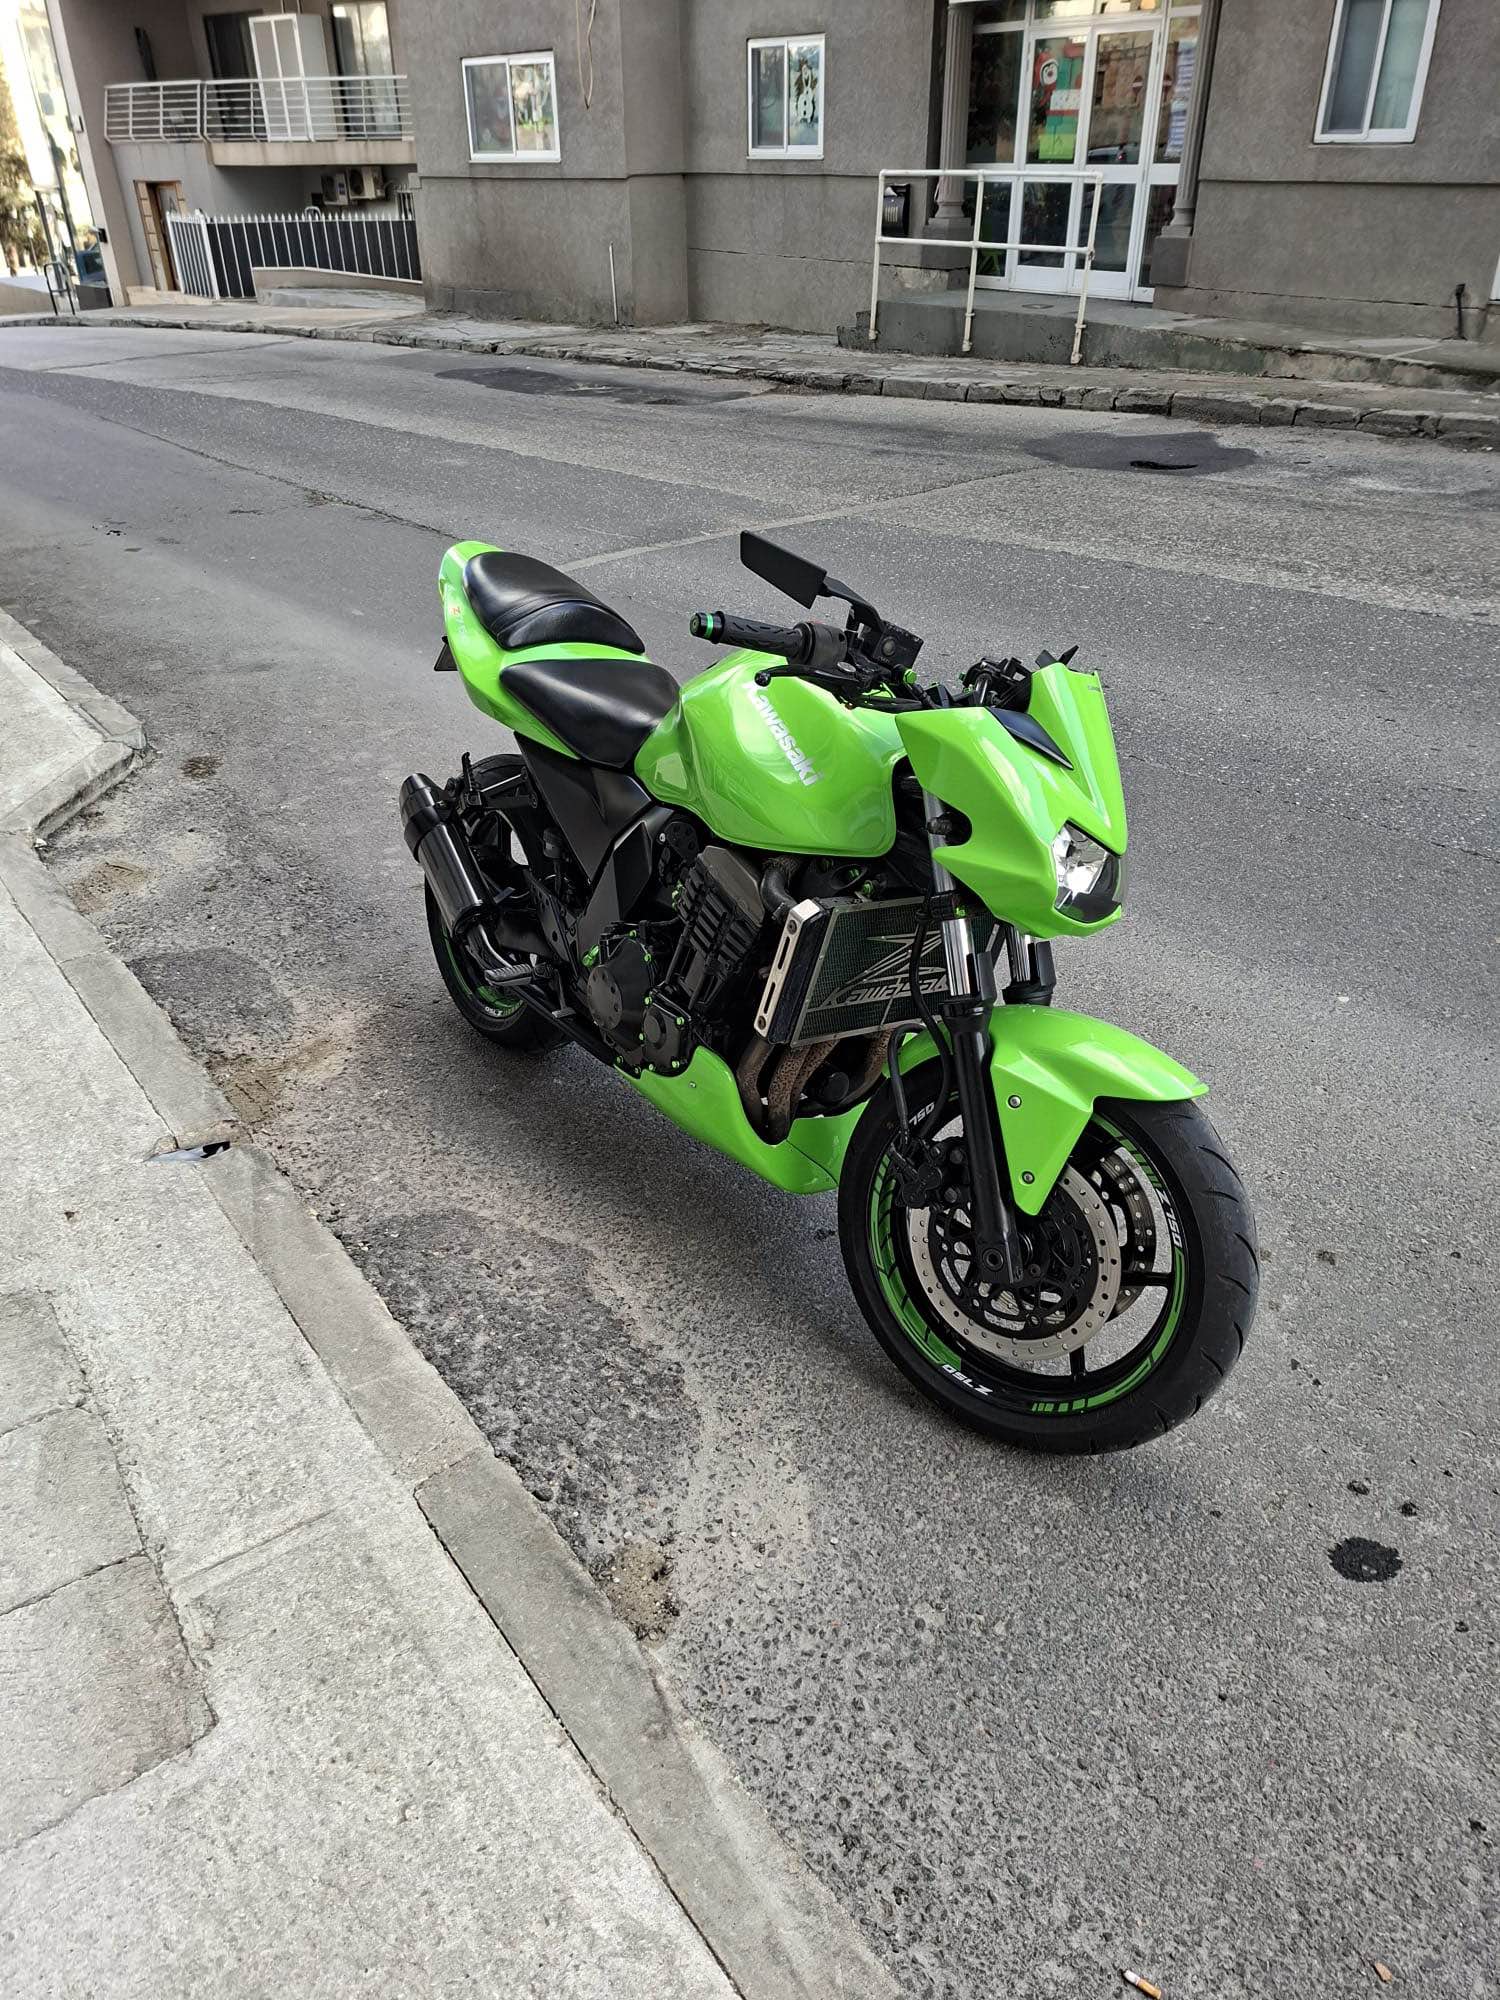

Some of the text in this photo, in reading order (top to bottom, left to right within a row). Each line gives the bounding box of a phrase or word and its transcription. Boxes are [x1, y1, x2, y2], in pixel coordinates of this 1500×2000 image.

[819, 975, 949, 1008] Kawasa
[908, 1101, 935, 1126] 750
[1156, 1188, 1183, 1248] Z750
[942, 1364, 994, 1396] Z750
